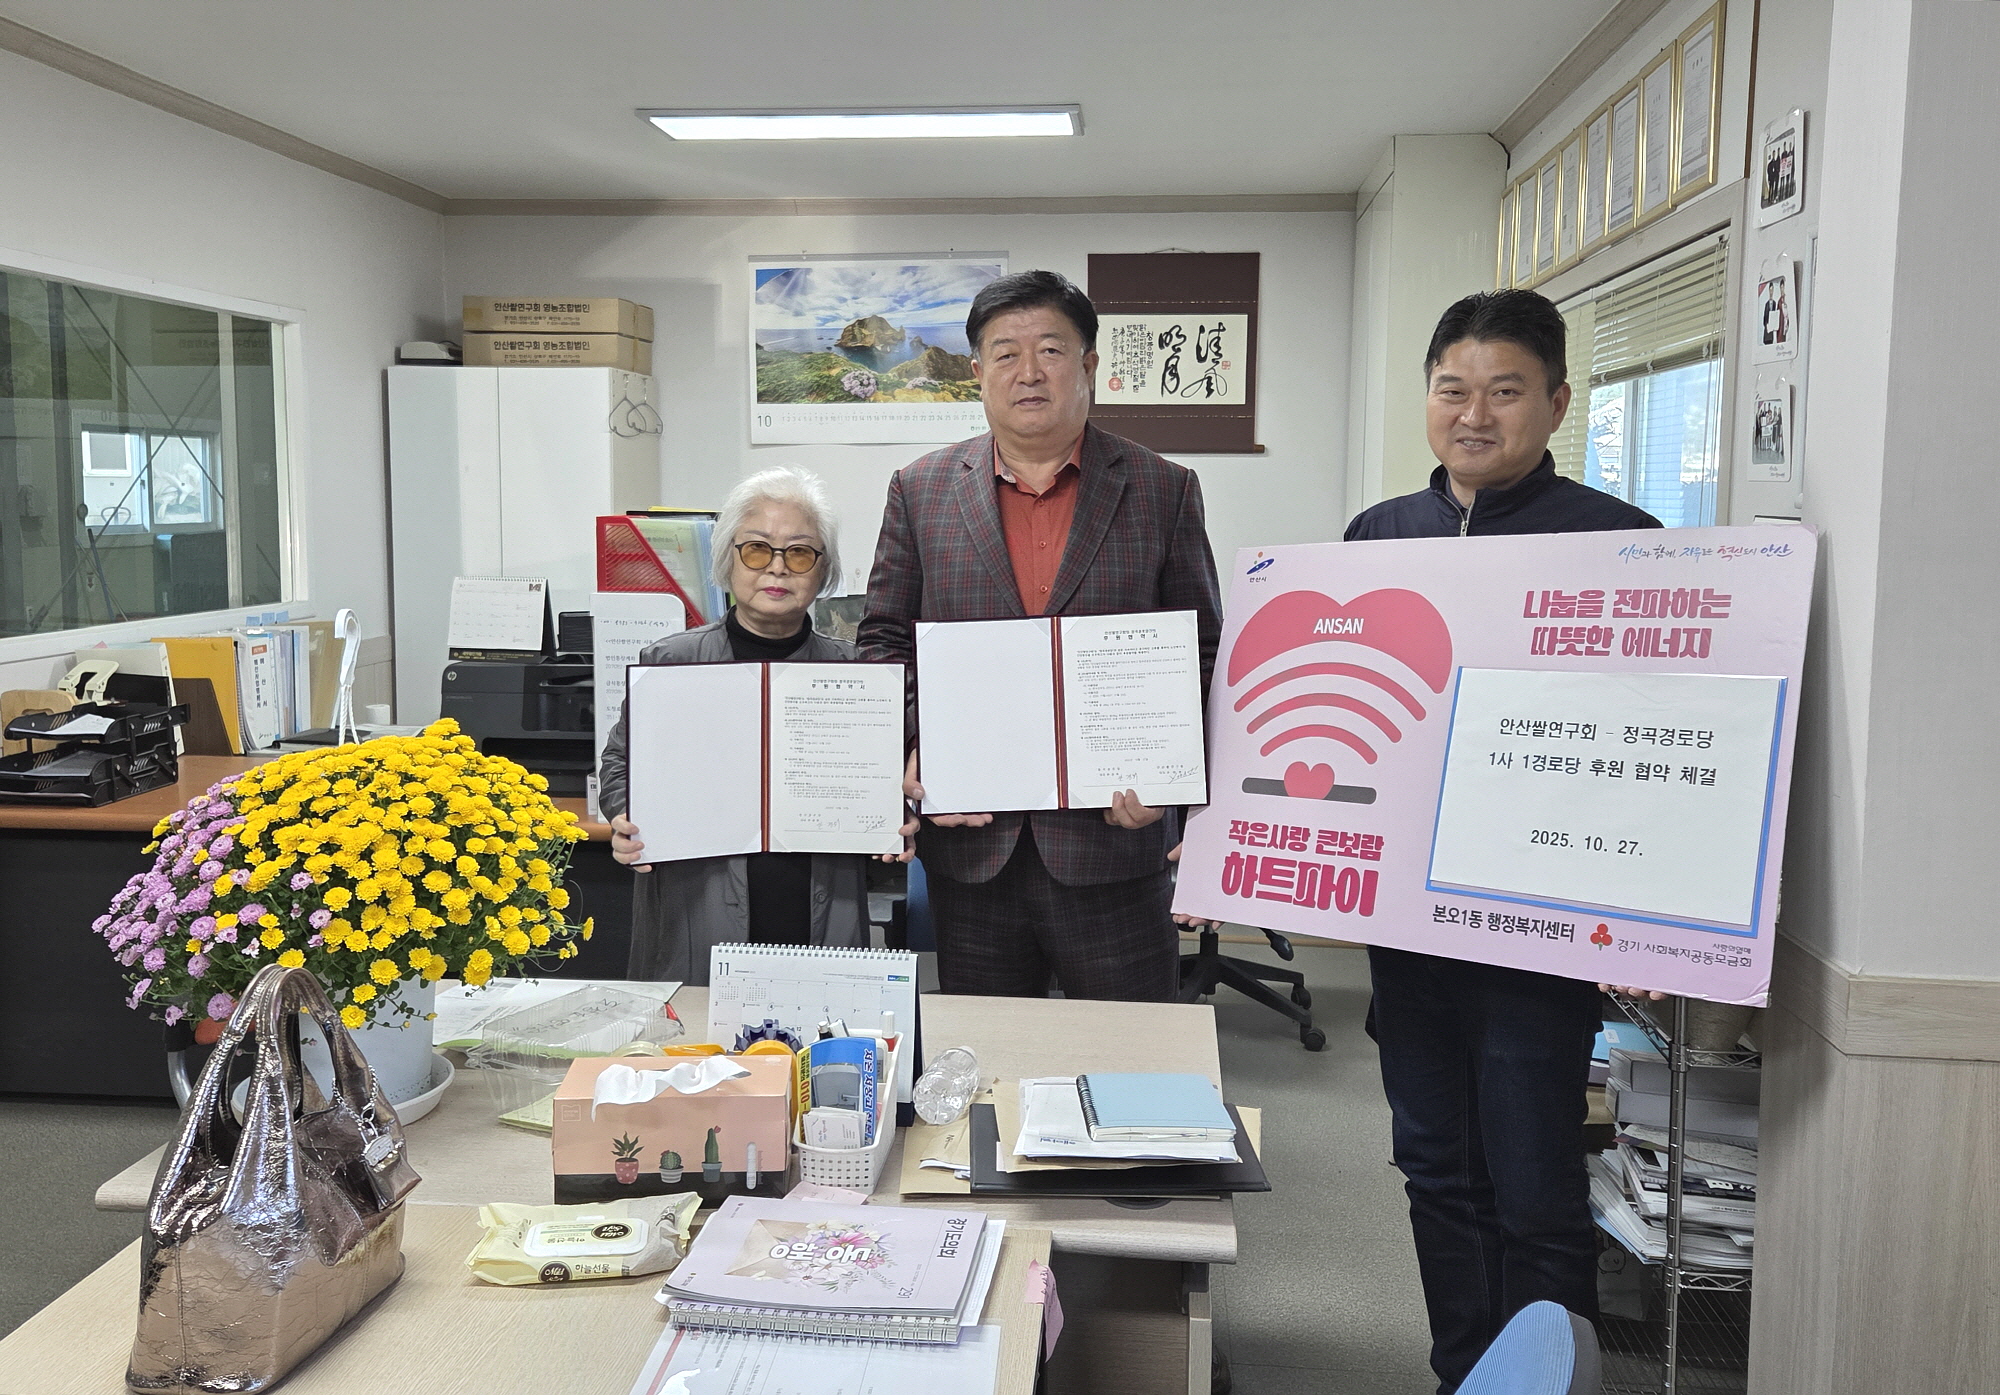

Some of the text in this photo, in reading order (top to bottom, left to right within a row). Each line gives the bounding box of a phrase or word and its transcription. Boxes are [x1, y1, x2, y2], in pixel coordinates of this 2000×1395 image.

[757, 415, 772, 427] 10
[1618, 544, 1652, 564] 시민과
[1760, 544, 1794, 557] 안산
[1523, 588, 1732, 618] 나눔을 전파하는
[1314, 618, 1364, 634] ANSAN
[1530, 626, 1712, 658] 따뜻한 에너지
[1500, 718, 1597, 741] 안산쌀연구회
[1622, 726, 1714, 749] 정곡경로당
[1488, 752, 1717, 786] 1사 1경로당 후원 협약 체결
[1229, 820, 1384, 861] 작은사랑 큰보람
[1531, 830, 1643, 856] 2025. 10. 27.
[1221, 852, 1379, 917] 하트파이
[1432, 904, 1576, 943] 본오1동 행정복지센터
[1618, 938, 1752, 968] 경기 사회복지공동모금회
[718, 962, 730, 976] 11
[864, 1074, 874, 1109] 저장고
[937, 1218, 968, 1260] 경기도의회
[575, 1263, 610, 1274] 하늘선물
[898, 1286, 912, 1300] 291
